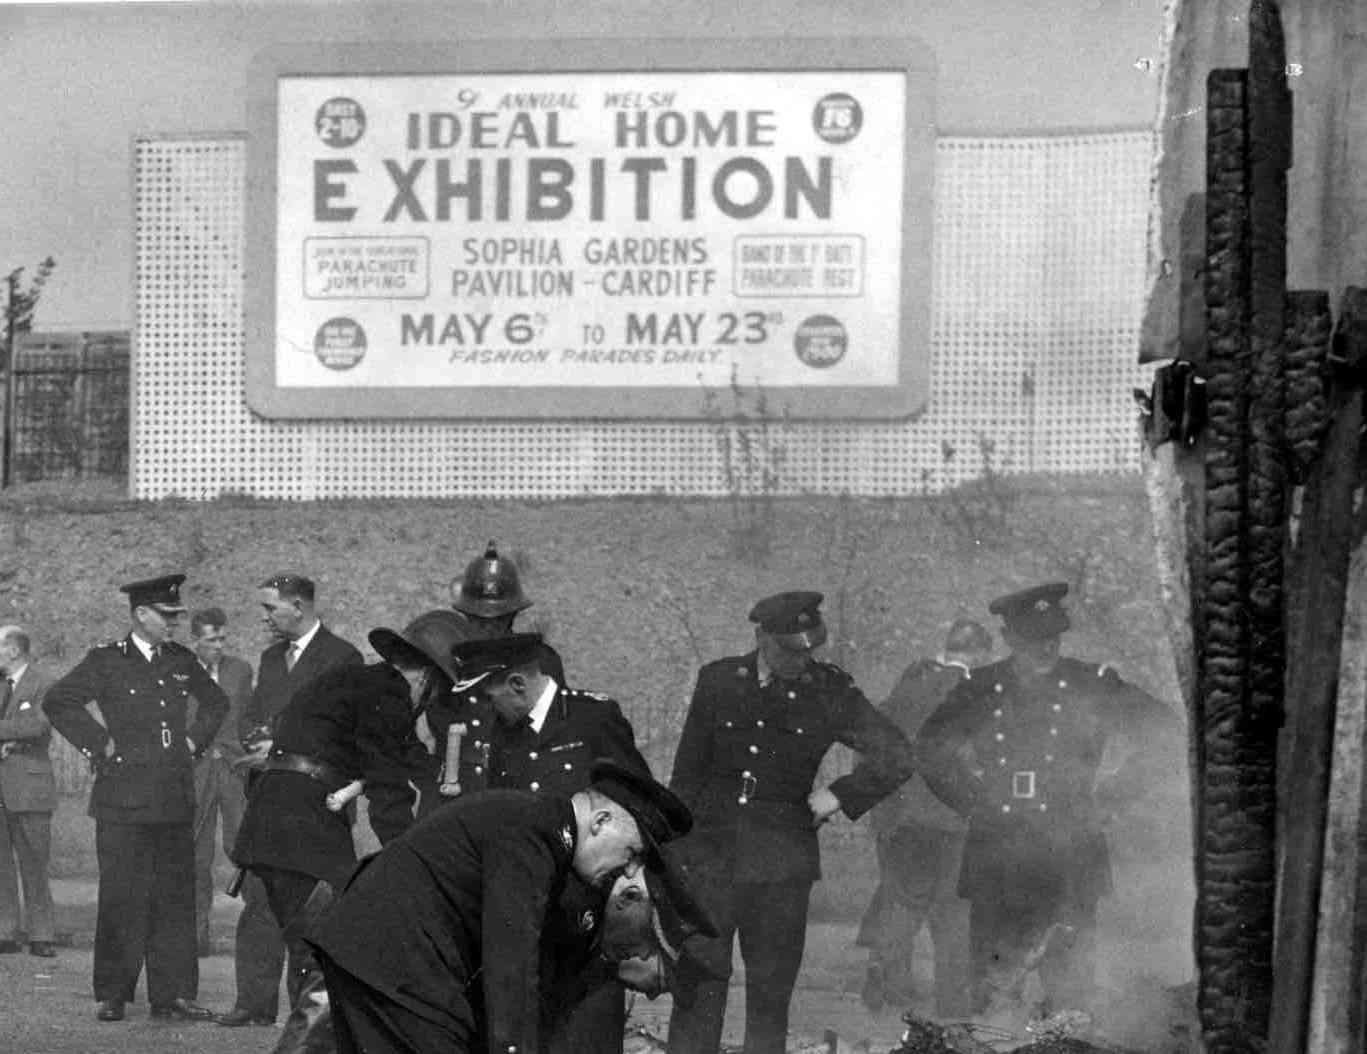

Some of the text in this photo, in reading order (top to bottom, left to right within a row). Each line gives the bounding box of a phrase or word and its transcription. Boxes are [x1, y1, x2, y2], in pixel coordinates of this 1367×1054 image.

[498, 91, 579, 109] ANNUAL
[604, 90, 676, 108] WELSH
[408, 109, 777, 150] IDEAL HOME
[314, 156, 832, 222] EXHIBITION
[462, 237, 708, 265] SOPHIA GARDENS
[318, 259, 416, 273] PARACHUTE
[322, 275, 407, 293] JUMPING
[451, 270, 574, 297] PAVILION
[601, 269, 716, 297] CARDIFF
[400, 313, 493, 346] MAY
[583, 324, 605, 344] TO
[626, 312, 704, 345] MAY
[449, 349, 721, 364] FASHION PARADES DAILY
